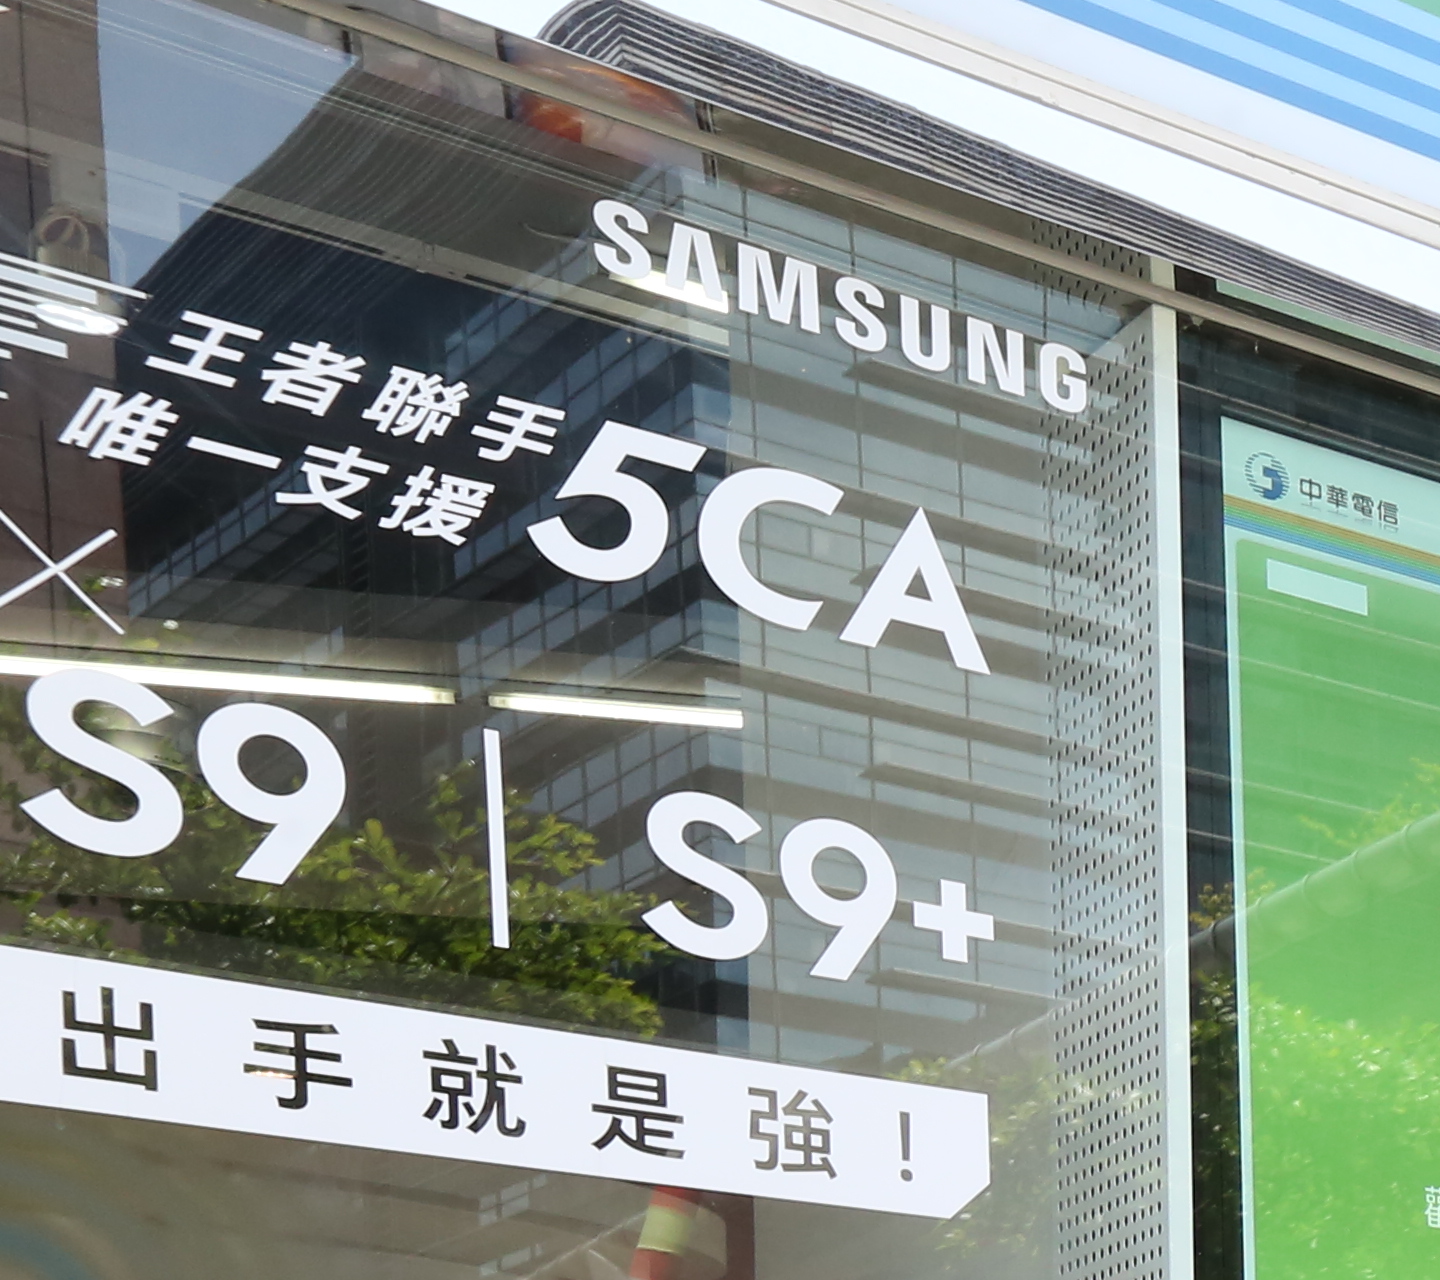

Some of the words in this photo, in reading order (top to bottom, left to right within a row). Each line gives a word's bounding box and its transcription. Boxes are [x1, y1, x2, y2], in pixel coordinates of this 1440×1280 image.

[145, 309, 568, 464] 王者聯手
[593, 199, 1088, 414] SAMSUNG
[57, 384, 497, 548] 唯一支援
[527, 420, 991, 676] 5CA
[1299, 476, 1399, 525] 中華電信
[20, 668, 348, 886] S9
[641, 792, 994, 982] S9+
